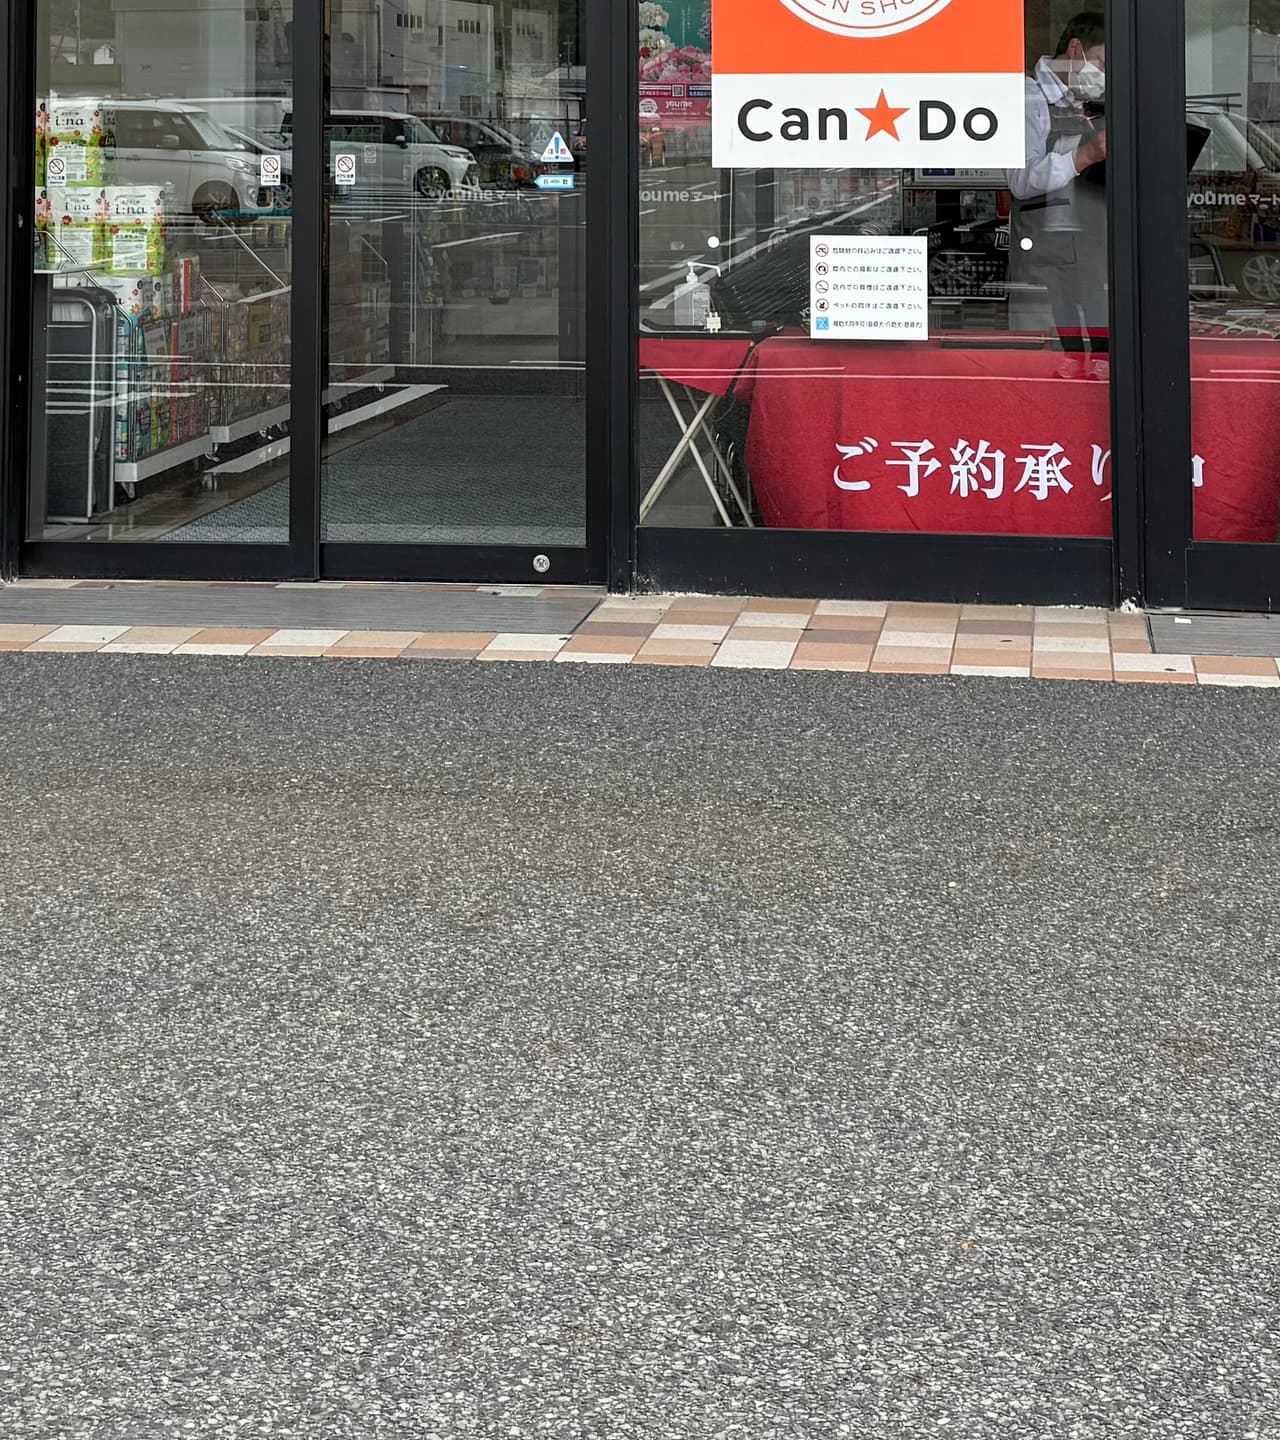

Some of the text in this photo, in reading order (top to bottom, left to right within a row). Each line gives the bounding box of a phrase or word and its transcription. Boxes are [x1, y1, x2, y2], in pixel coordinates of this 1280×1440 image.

[737, 98, 999, 141] Can Do
[641, 190, 690, 202] oume
[833, 436, 1205, 501] ご予約承り
